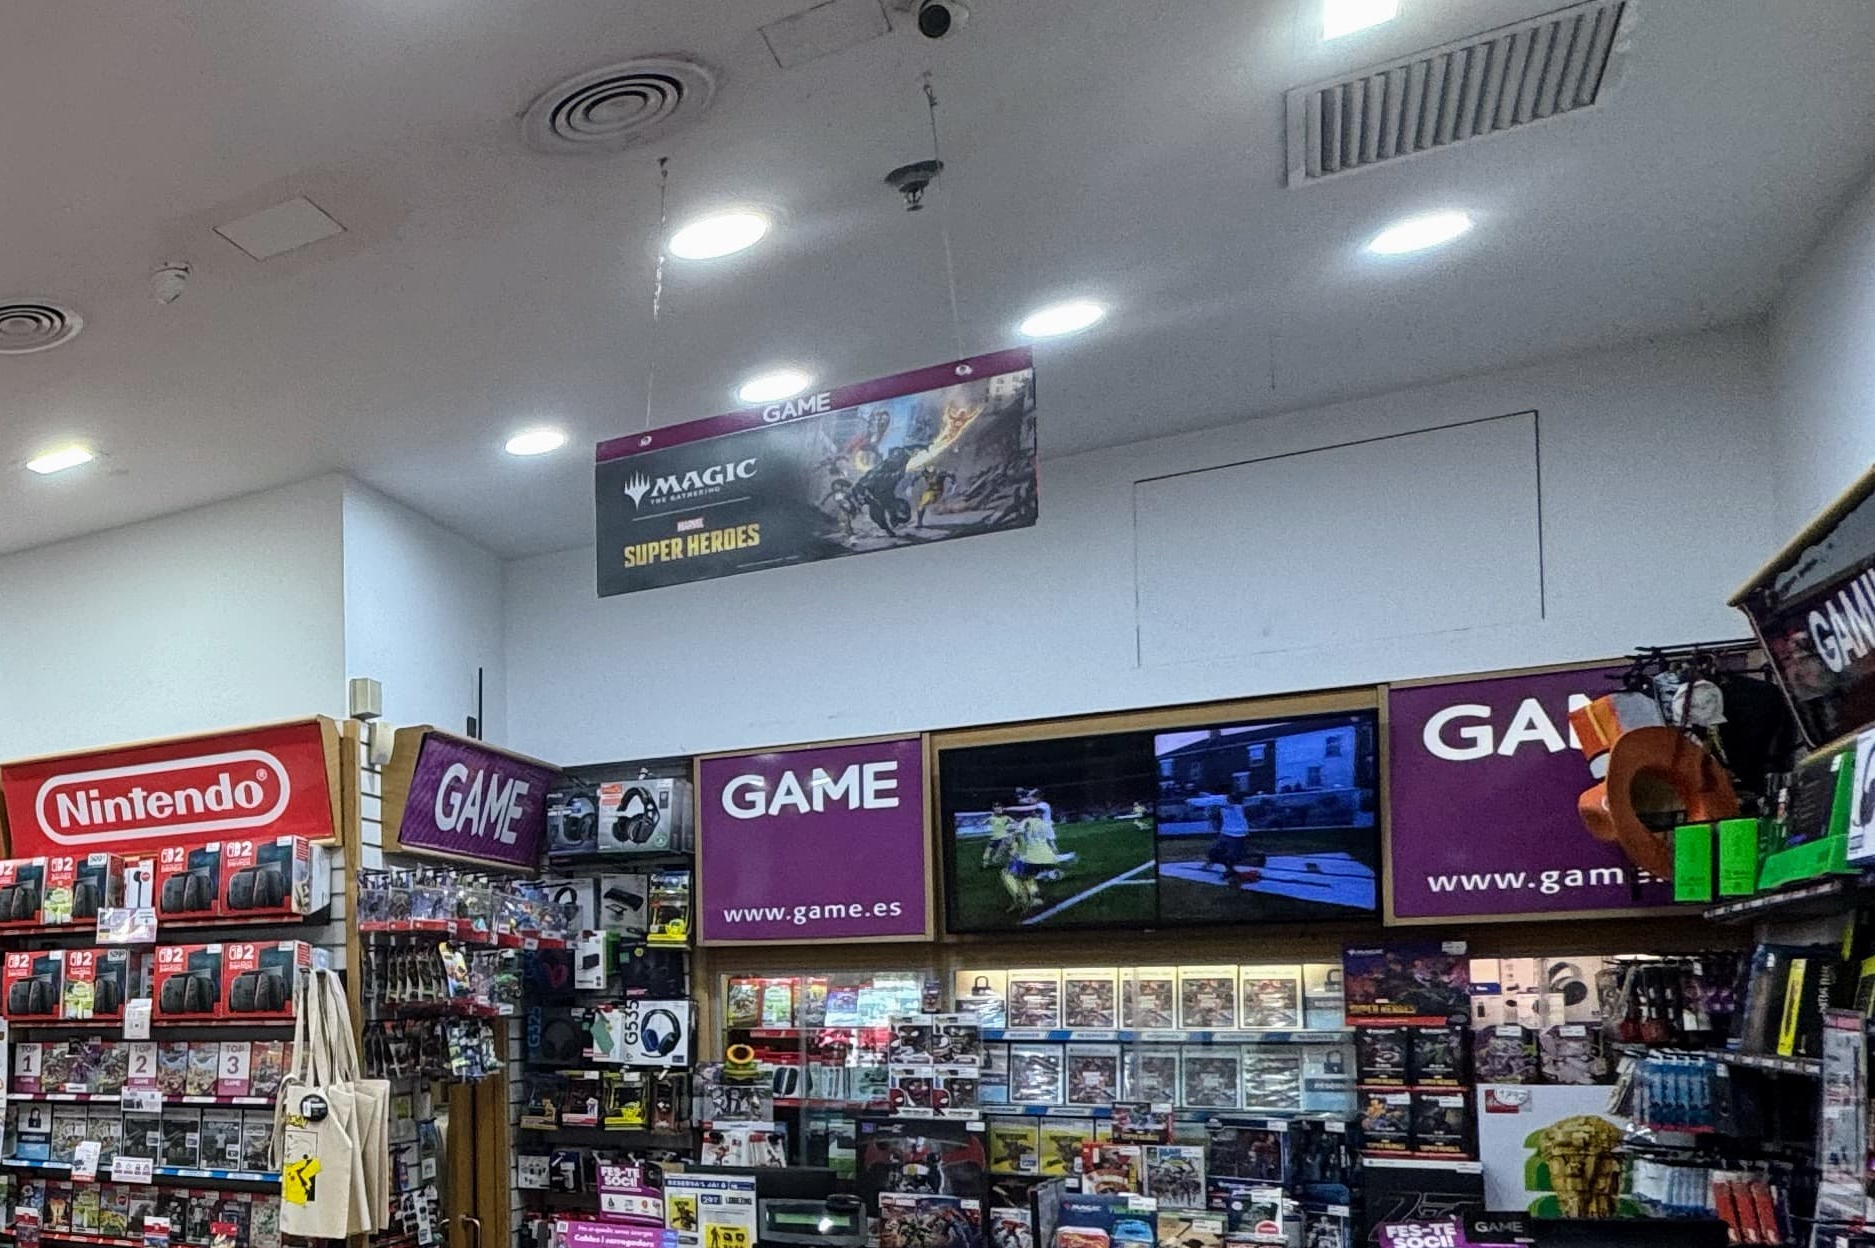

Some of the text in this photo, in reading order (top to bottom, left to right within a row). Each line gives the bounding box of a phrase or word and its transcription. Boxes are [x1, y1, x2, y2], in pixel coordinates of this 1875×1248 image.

[763, 392, 831, 423] GAME
[649, 458, 757, 497] MAGIC
[670, 486, 721, 501] GATHERING
[677, 517, 704, 532] MARVEL
[624, 524, 760, 567] SUPER HEROES
[722, 761, 900, 820] GAME
[56, 774, 264, 828] Nintendo
[434, 763, 529, 845] GAME
[723, 903, 902, 925] www.game.es
[625, 1000, 639, 1046] G535
[23, 1055, 32, 1072] 1
[135, 1055, 147, 1073] 2
[227, 1056, 239, 1073] 3
[601, 1167, 639, 1179] FES-TE
[1386, 1221, 1456, 1241] FES-TE
[1475, 1220, 1523, 1233] GAME
[574, 1234, 600, 1242] Cables
[606, 1238, 654, 1248] carregadors
